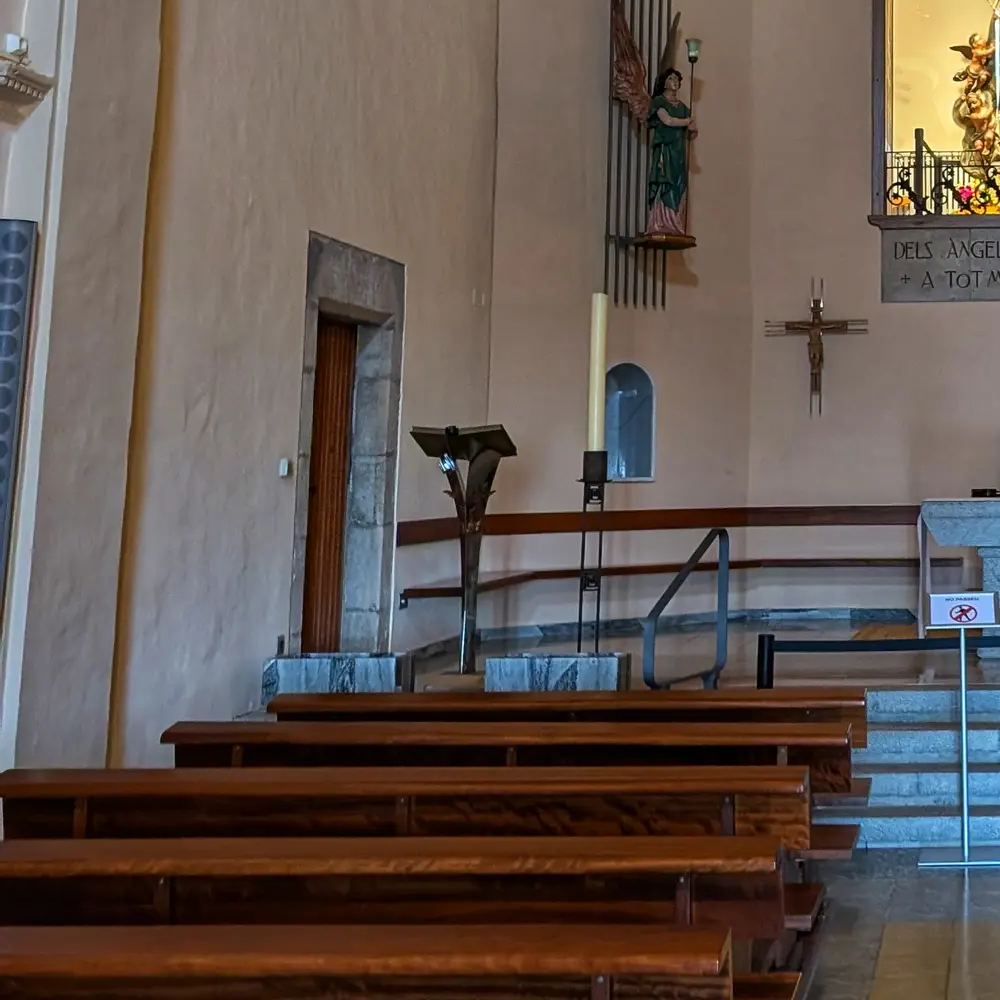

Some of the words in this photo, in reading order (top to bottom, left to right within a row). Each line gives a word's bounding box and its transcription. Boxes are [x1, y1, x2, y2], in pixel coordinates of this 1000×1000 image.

[894, 241, 934, 260] DELS
[921, 270, 935, 289] A
[944, 270, 984, 289] TOT
